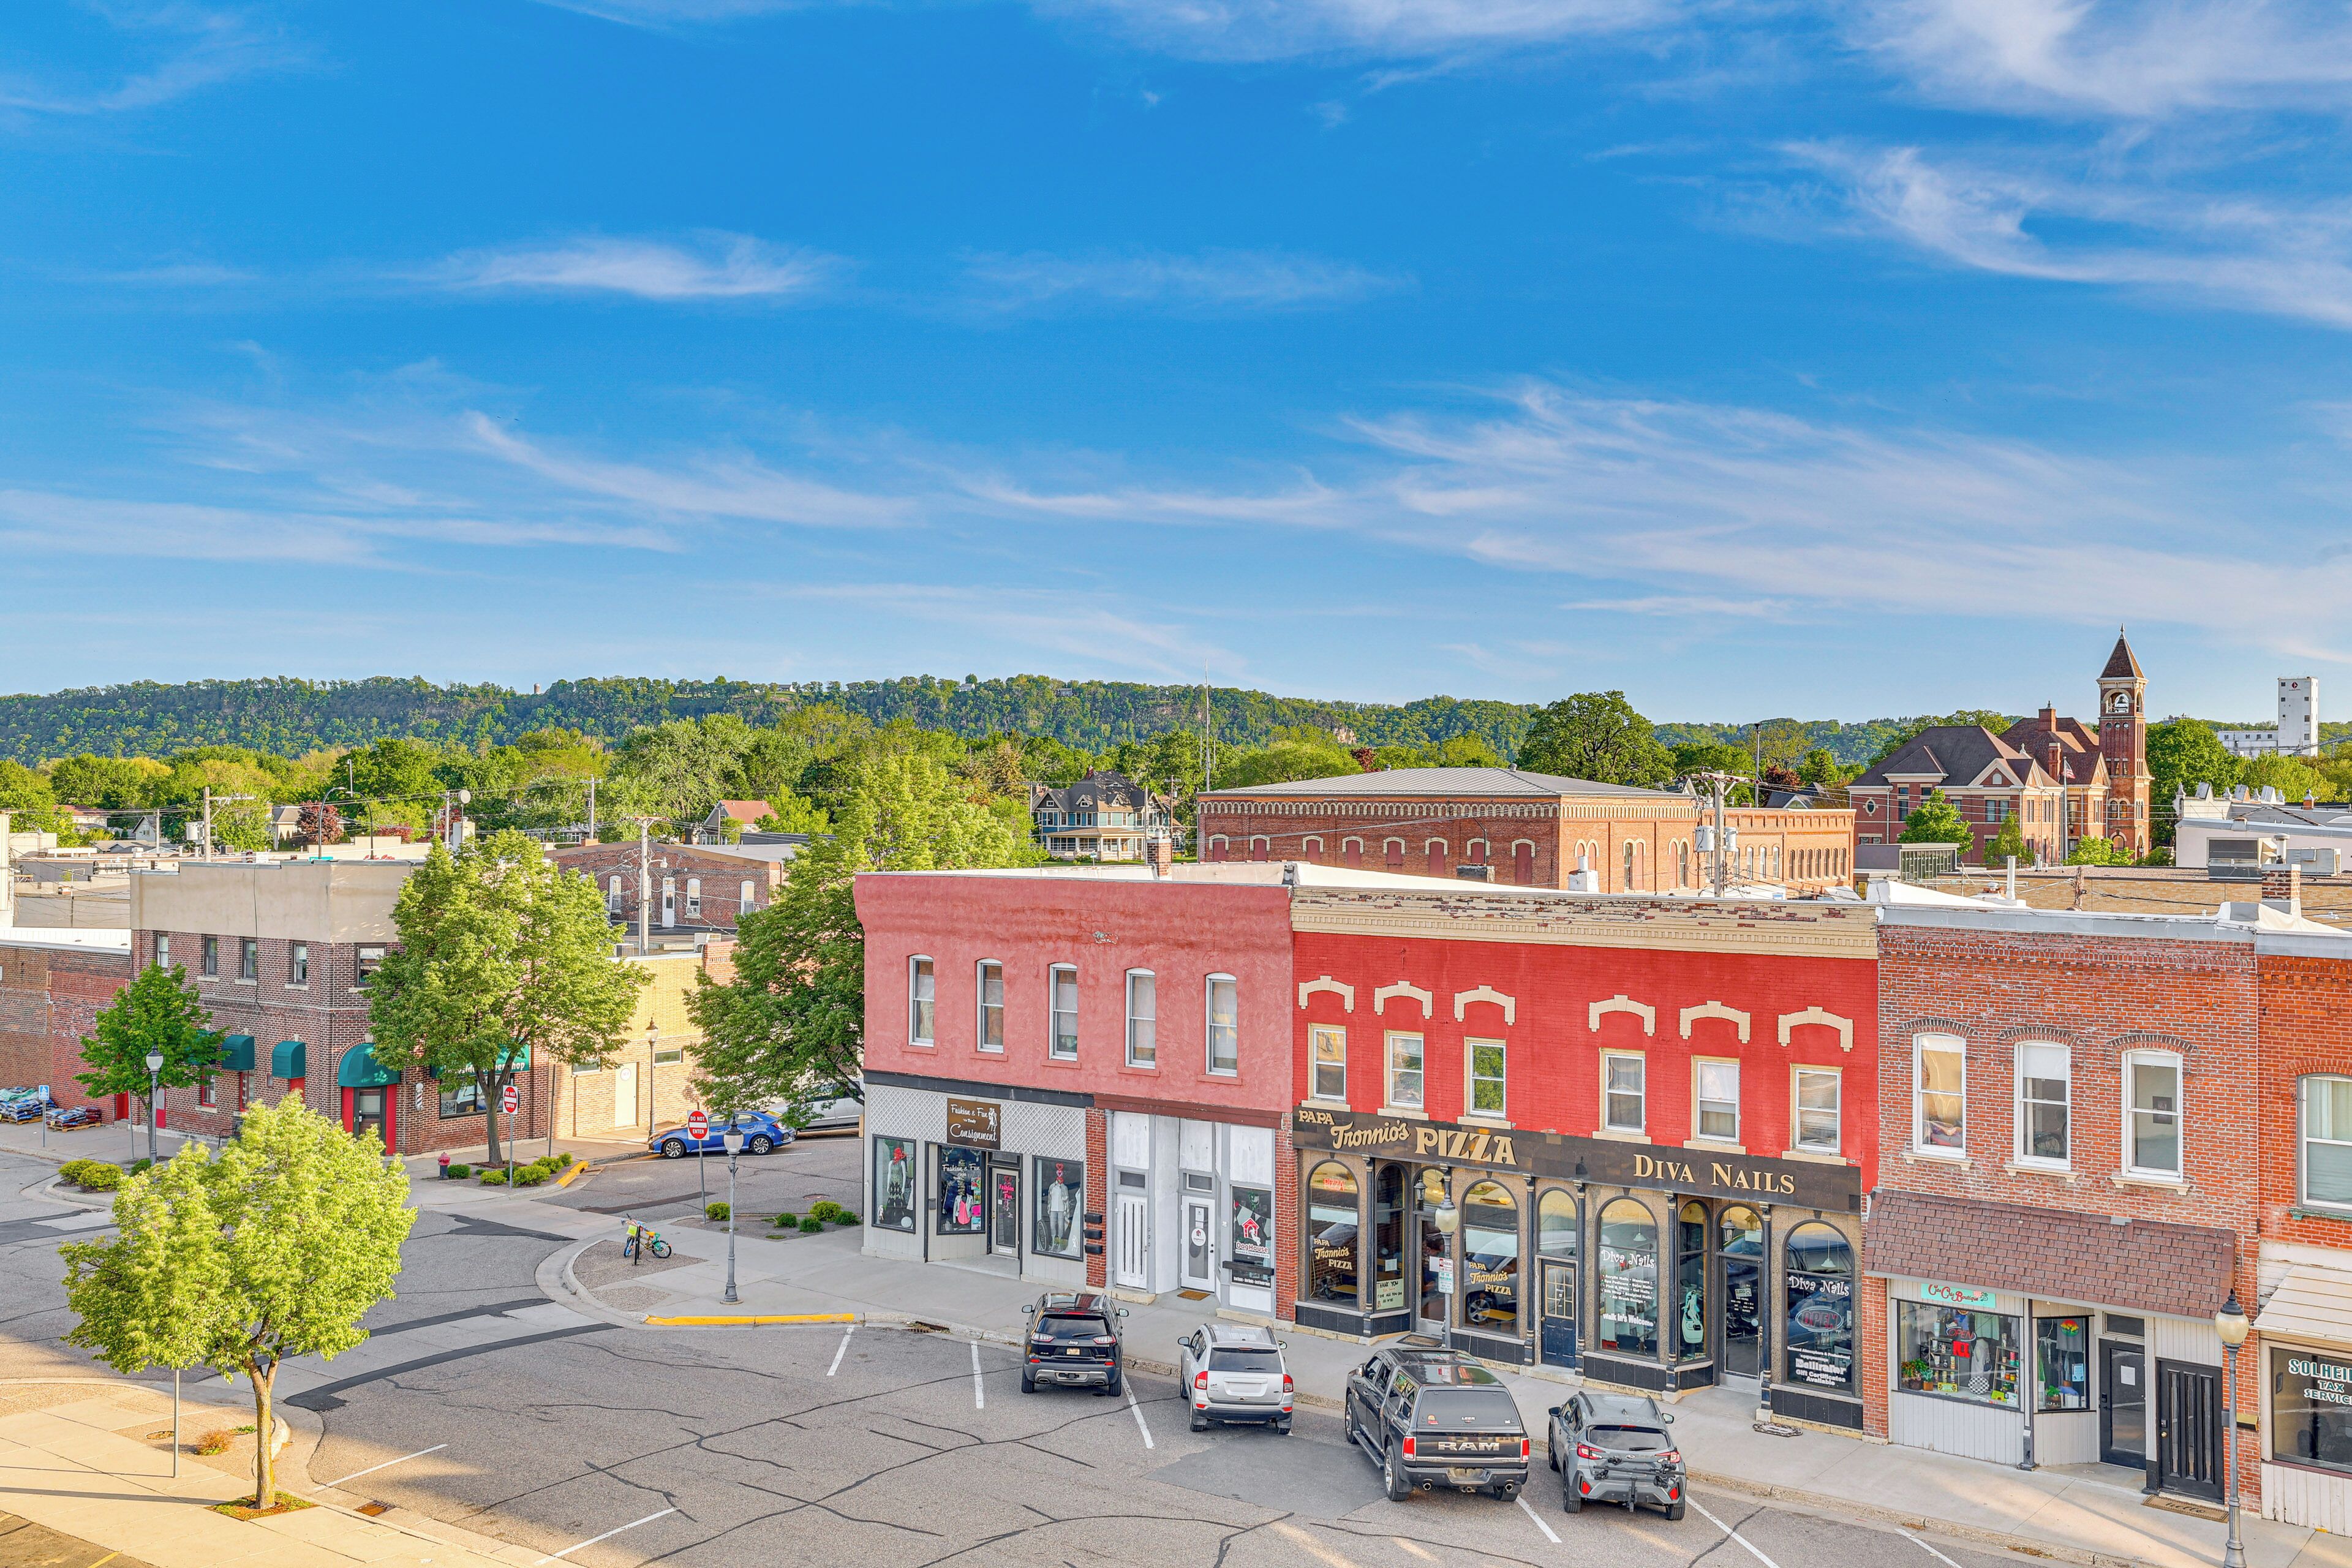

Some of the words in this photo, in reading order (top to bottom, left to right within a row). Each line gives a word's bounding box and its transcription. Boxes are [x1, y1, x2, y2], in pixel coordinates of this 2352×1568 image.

[951, 1104, 970, 1116] Fashion
[976, 1107, 988, 1118] Fun
[1298, 1110, 1335, 1125] PAPA
[950, 1123, 998, 1142] Consignment
[1330, 1120, 1411, 1149] Tronnio's
[1415, 1127, 1518, 1166] PIZZA
[1324, 1178, 1345, 1191] PIZZA
[1236, 1242, 1268, 1253] DogHouse
[1313, 1238, 1330, 1246] PAPA
[1314, 1246, 1350, 1259] Tronnio's
[1601, 1250, 1625, 1264] Diva
[1629, 1253, 1655, 1268] Nails
[1328, 1259, 1352, 1270] PIZZA
[1468, 1262, 1487, 1271] PAPA
[1469, 1270, 1509, 1284] Tronnio's
[1485, 1283, 1512, 1295] PIZZA
[1789, 1275, 1816, 1291] Diva
[1820, 1280, 1849, 1297] Nails
[1951, 1291, 1978, 1302] Boutique
[1628, 1314, 1654, 1327] Welcome
[1801, 1311, 1838, 1330] OPEN
[1948, 1329, 1973, 1340] OPEN
[1806, 1376, 1836, 1386] Available
[2317, 1379, 2345, 1393] TAX
[1438, 1441, 1500, 1451] RAM
